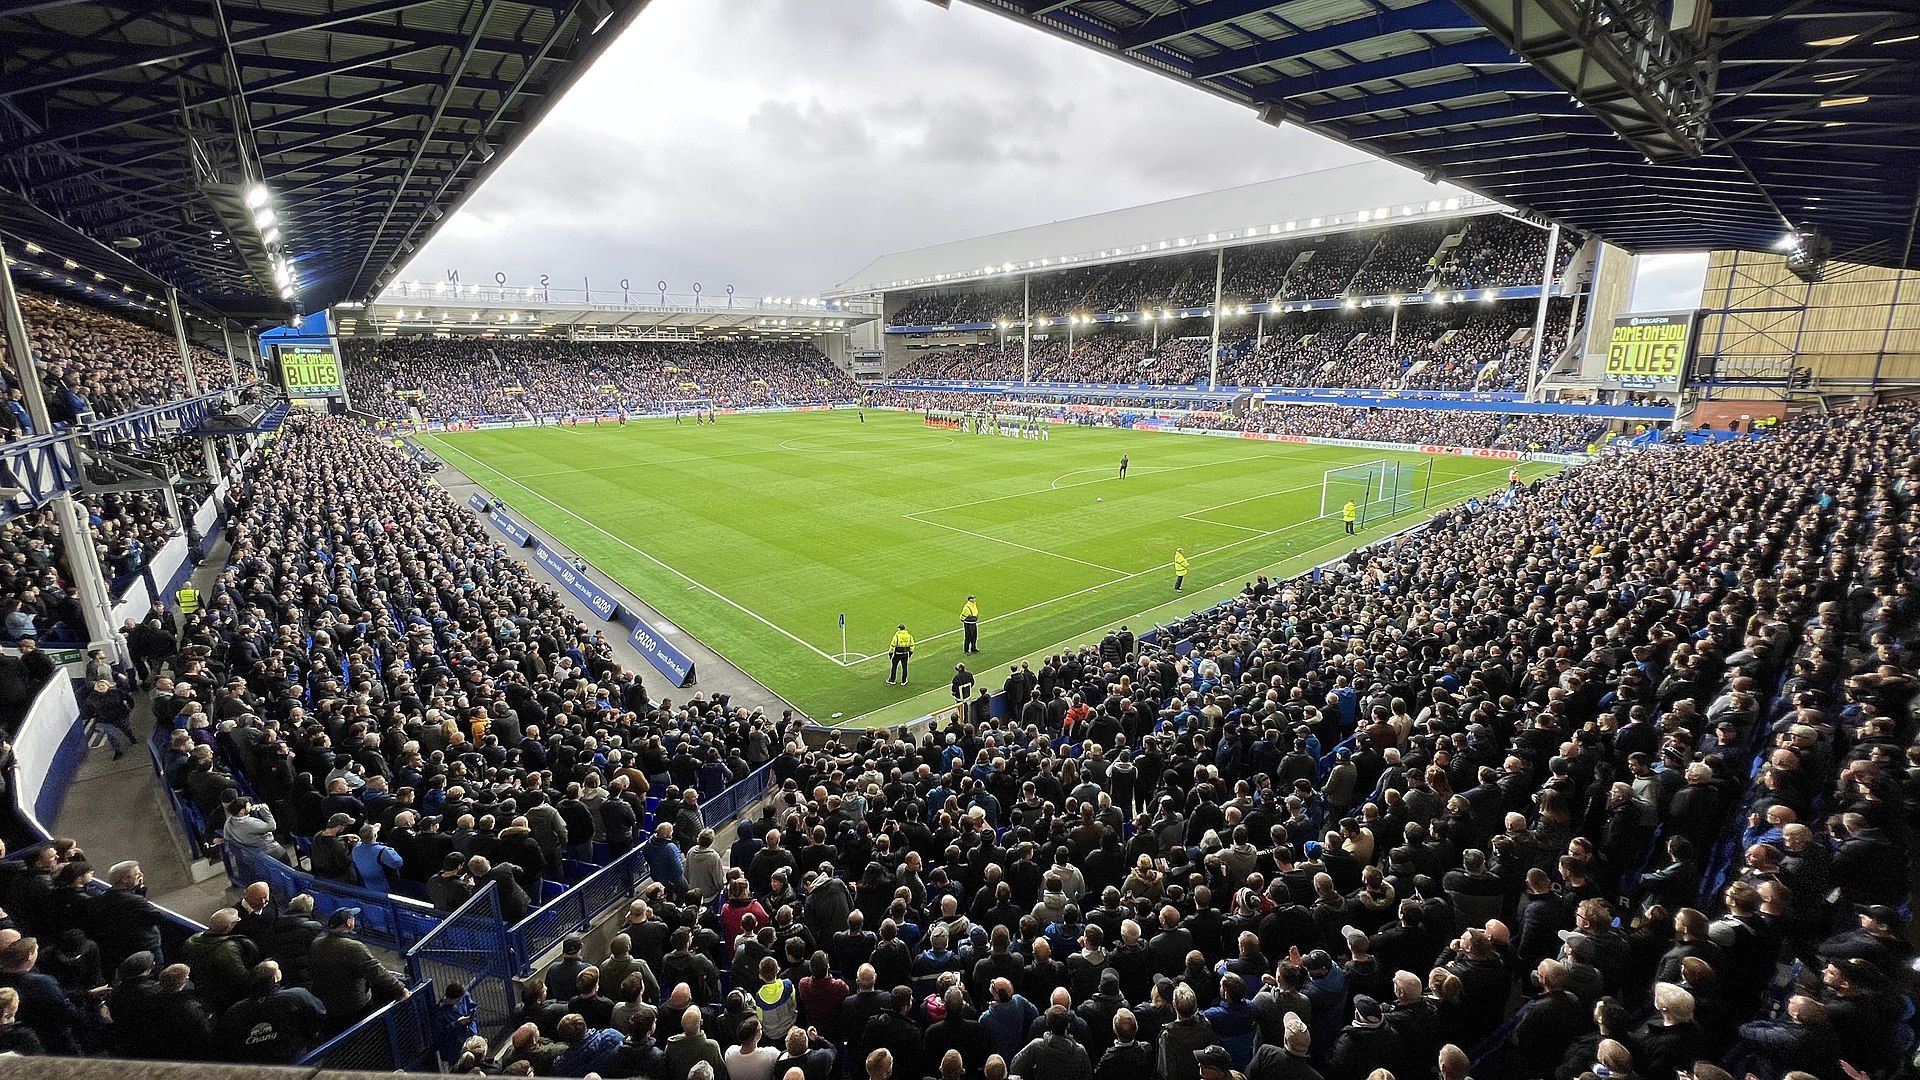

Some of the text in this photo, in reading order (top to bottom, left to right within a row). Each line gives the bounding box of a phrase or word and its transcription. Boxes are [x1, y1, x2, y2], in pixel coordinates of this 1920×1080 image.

[1612, 324, 1687, 341] COME ON YOU
[283, 354, 335, 364] COME ON YOU
[1608, 344, 1680, 372] BLUES
[286, 366, 336, 385] BLUES
[1420, 446, 1462, 455] CAZO
[1472, 450, 1518, 459] CAZOO
[593, 595, 612, 614] CAZOO
[634, 628, 657, 652] CAZOO
[245, 1031, 278, 1045] Chang
